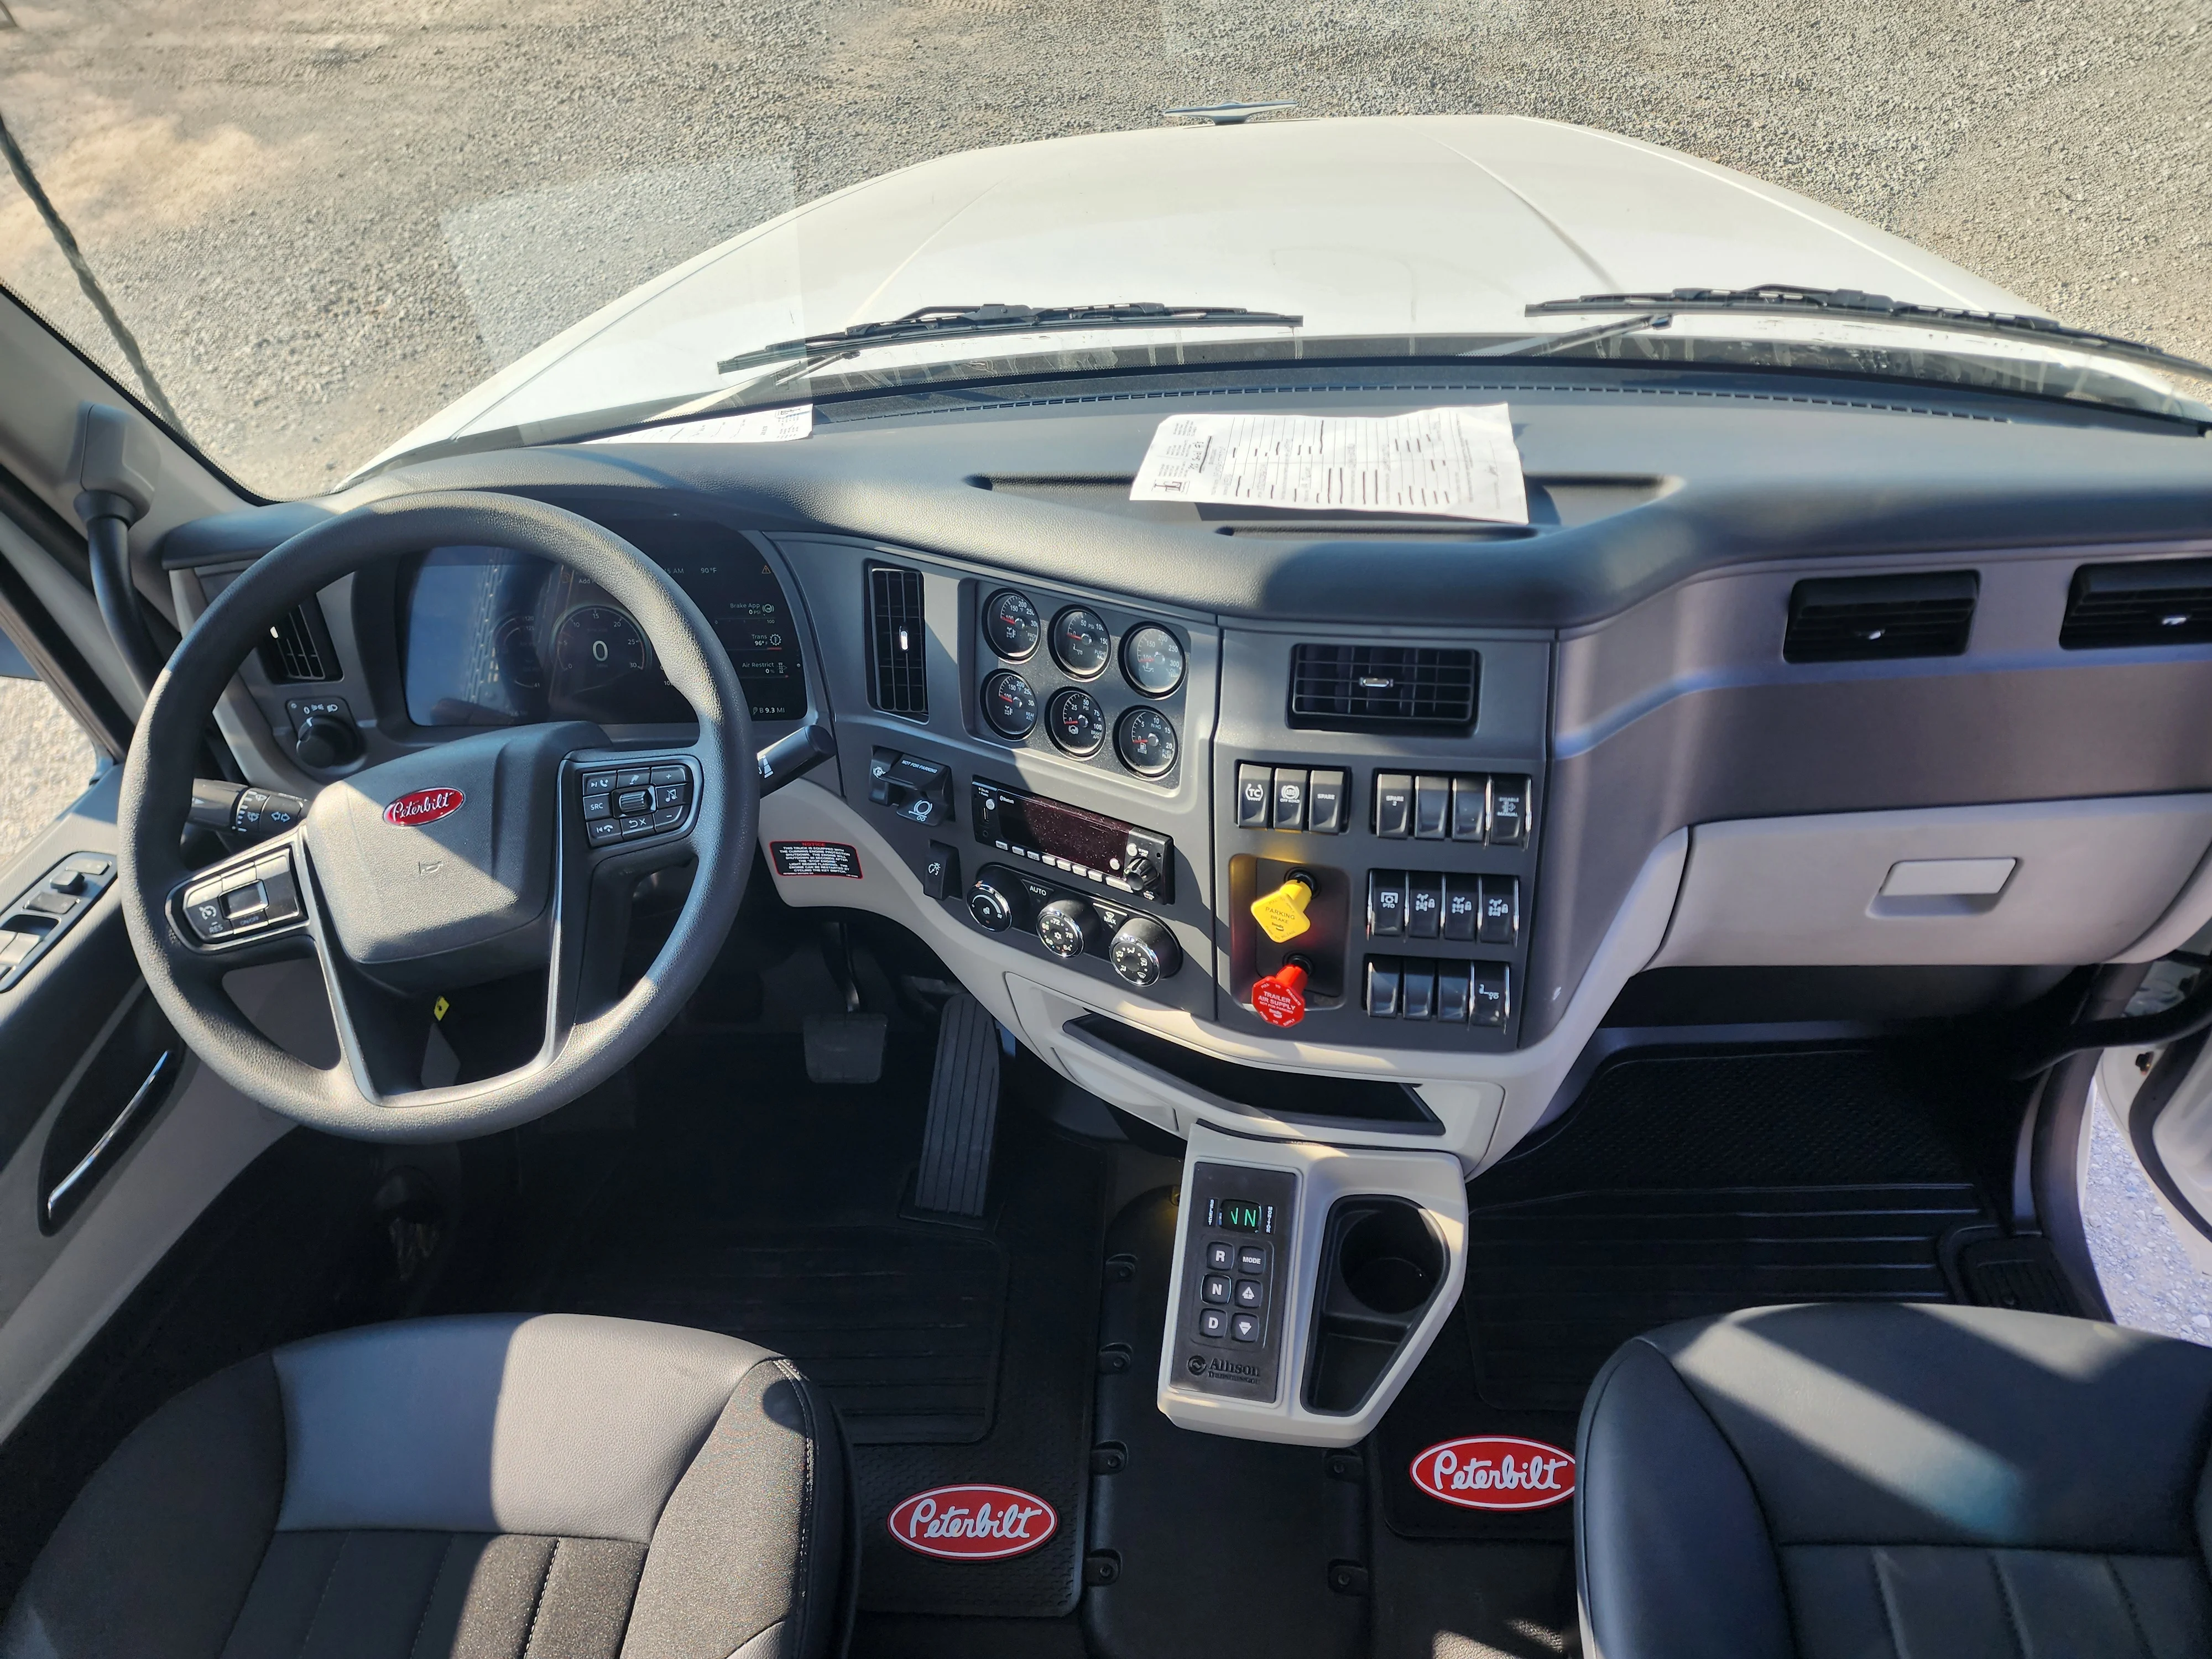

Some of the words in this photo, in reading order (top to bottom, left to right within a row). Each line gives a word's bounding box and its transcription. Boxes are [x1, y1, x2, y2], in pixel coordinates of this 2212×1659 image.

[592, 640, 608, 661] 0
[919, 765, 937, 774] PARKING
[1248, 788, 1261, 797] TC
[393, 792, 455, 822] Peterbilt
[590, 802, 604, 811] SRC
[1030, 885, 1047, 896] AUTO
[1265, 906, 1295, 920] PARKING
[1104, 916, 1117, 925] MAX
[1270, 915, 1288, 924] BRAKE
[209, 924, 223, 934] RES
[1258, 995, 1269, 1003] AIR
[1269, 998, 1296, 1011] SUPPLY
[1263, 990, 1291, 1004] TRAILER
[1215, 1250, 1225, 1262] R
[1242, 1256, 1261, 1265] MODE
[1212, 1283, 1222, 1296] N
[1208, 1317, 1219, 1329] D
[1209, 1357, 1261, 1377] Allison
[1434, 1449, 1568, 1490] Peterbilt
[910, 1498, 1043, 1538] Peterbilt
